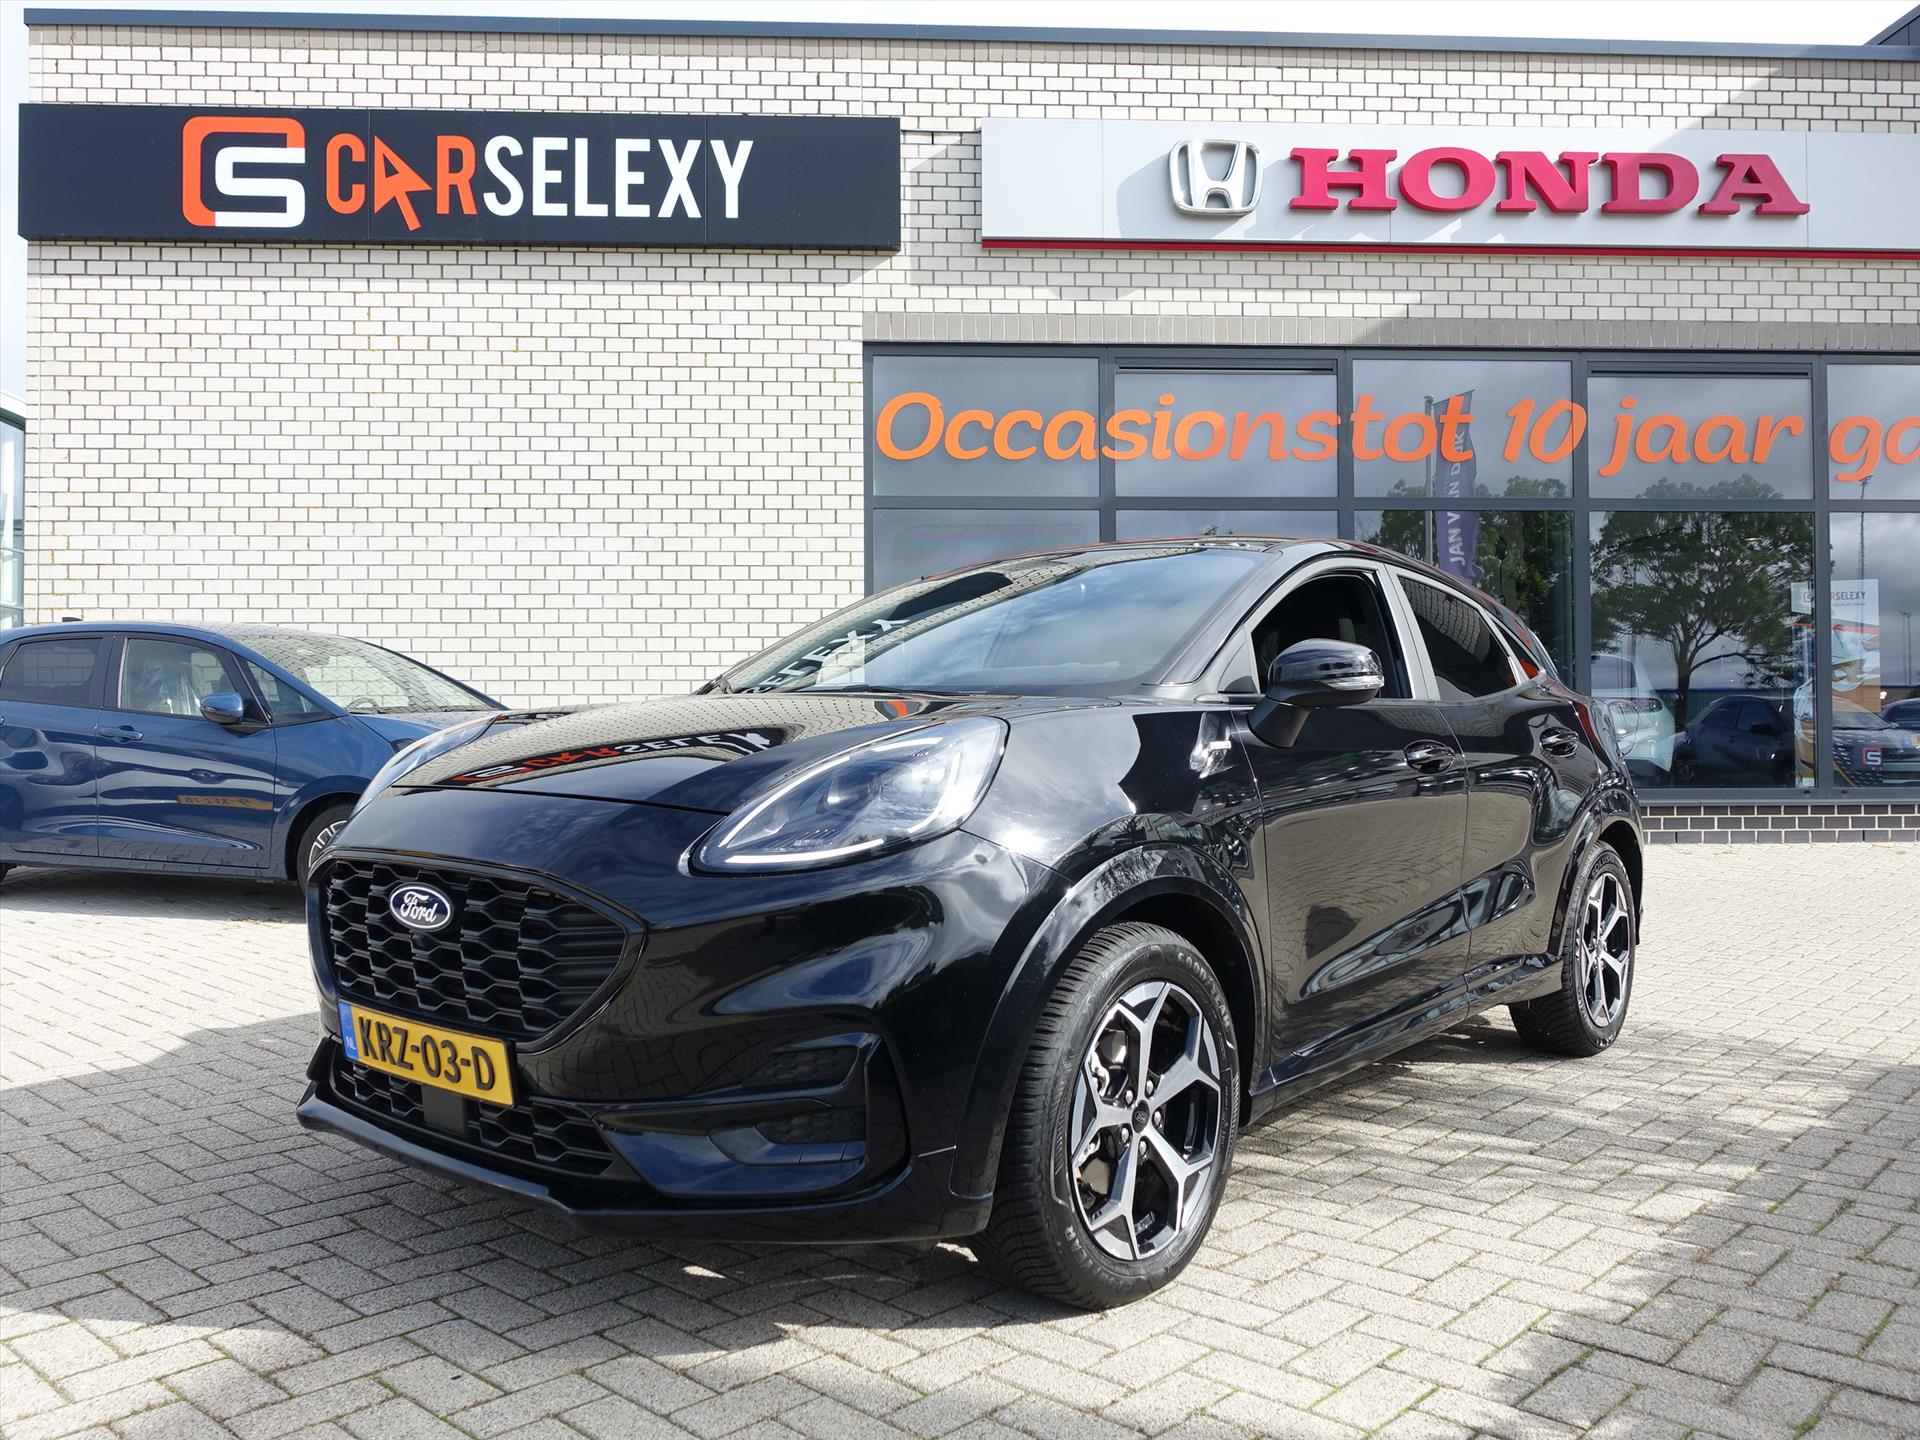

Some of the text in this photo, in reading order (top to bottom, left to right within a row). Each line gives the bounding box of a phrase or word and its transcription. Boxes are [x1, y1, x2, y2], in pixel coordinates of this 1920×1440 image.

[326, 133, 754, 231] CARSELEXY
[1290, 146, 1810, 216] HONDA
[1504, 396, 1588, 464] 10
[1599, 396, 1805, 478] jaar
[1447, 478, 1463, 526] VN
[1449, 527, 1466, 567] JAN
[400, 891, 439, 923] Ford
[358, 1016, 495, 1091] KRZ-03-D
